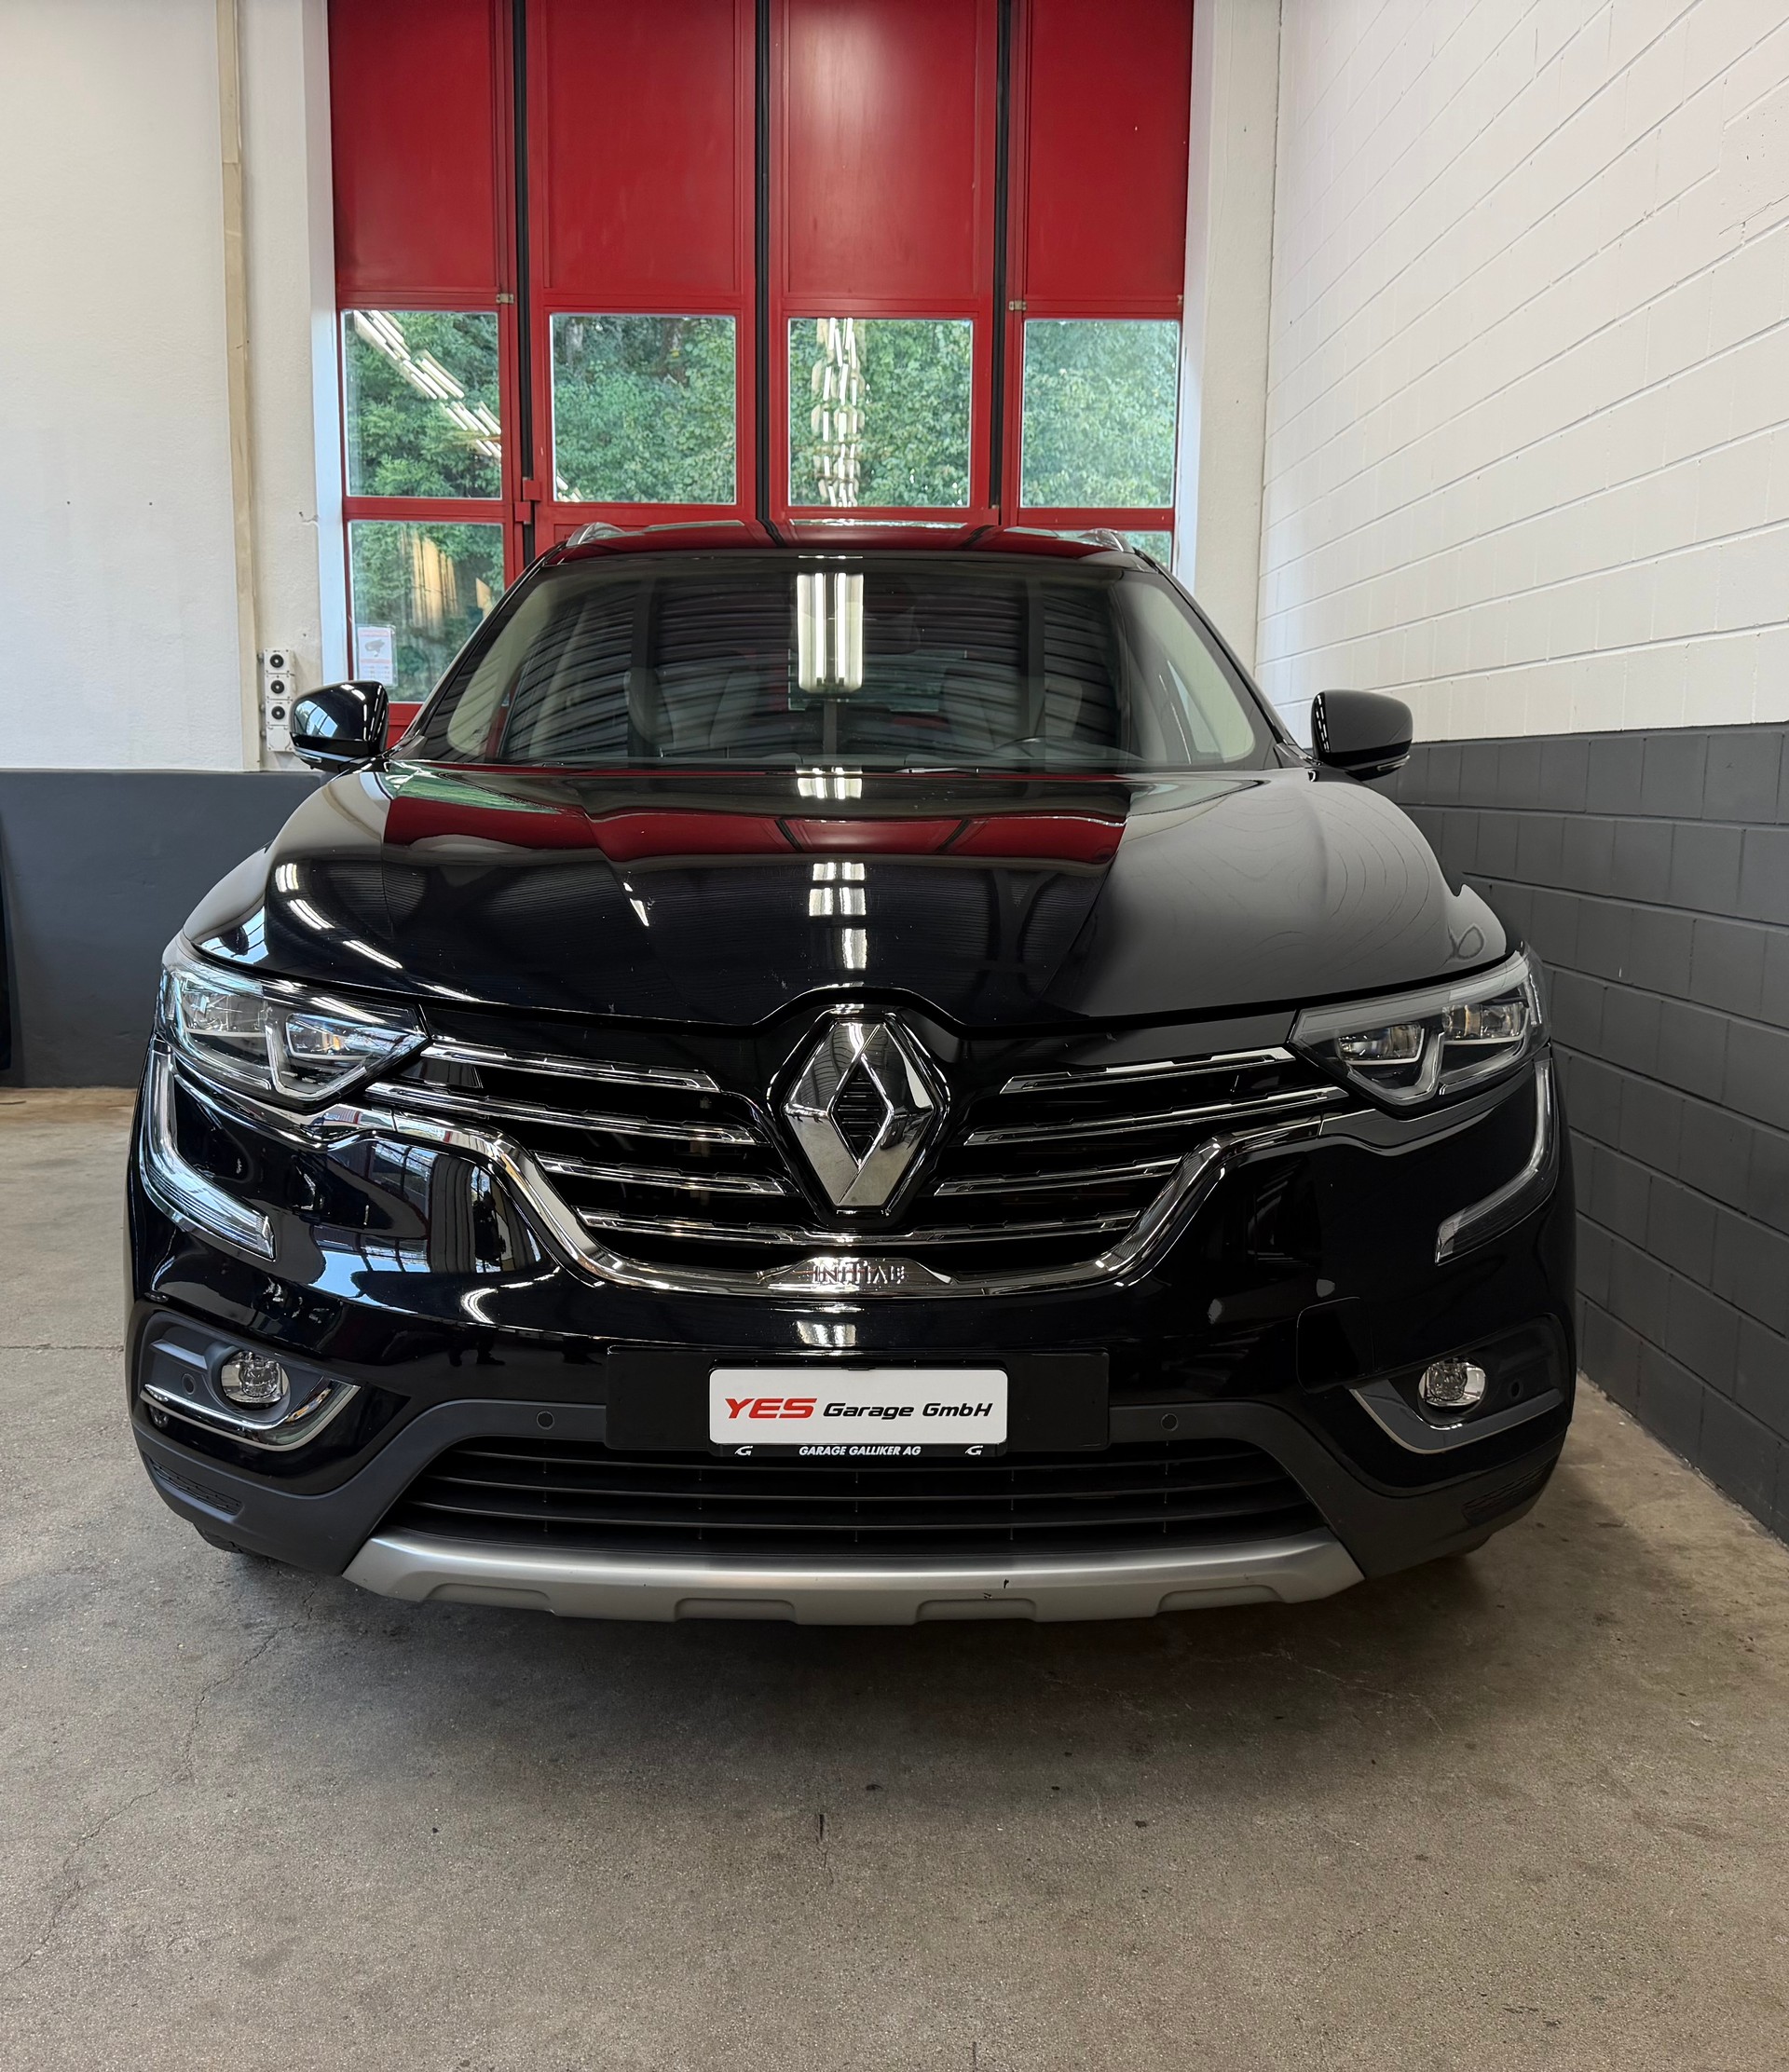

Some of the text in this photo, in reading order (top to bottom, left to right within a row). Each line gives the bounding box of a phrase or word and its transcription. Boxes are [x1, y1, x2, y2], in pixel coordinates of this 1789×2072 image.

[725, 1397, 993, 1420] YES Garage GmbH
[799, 1445, 922, 1456] GARAGE GALLIKER AG
